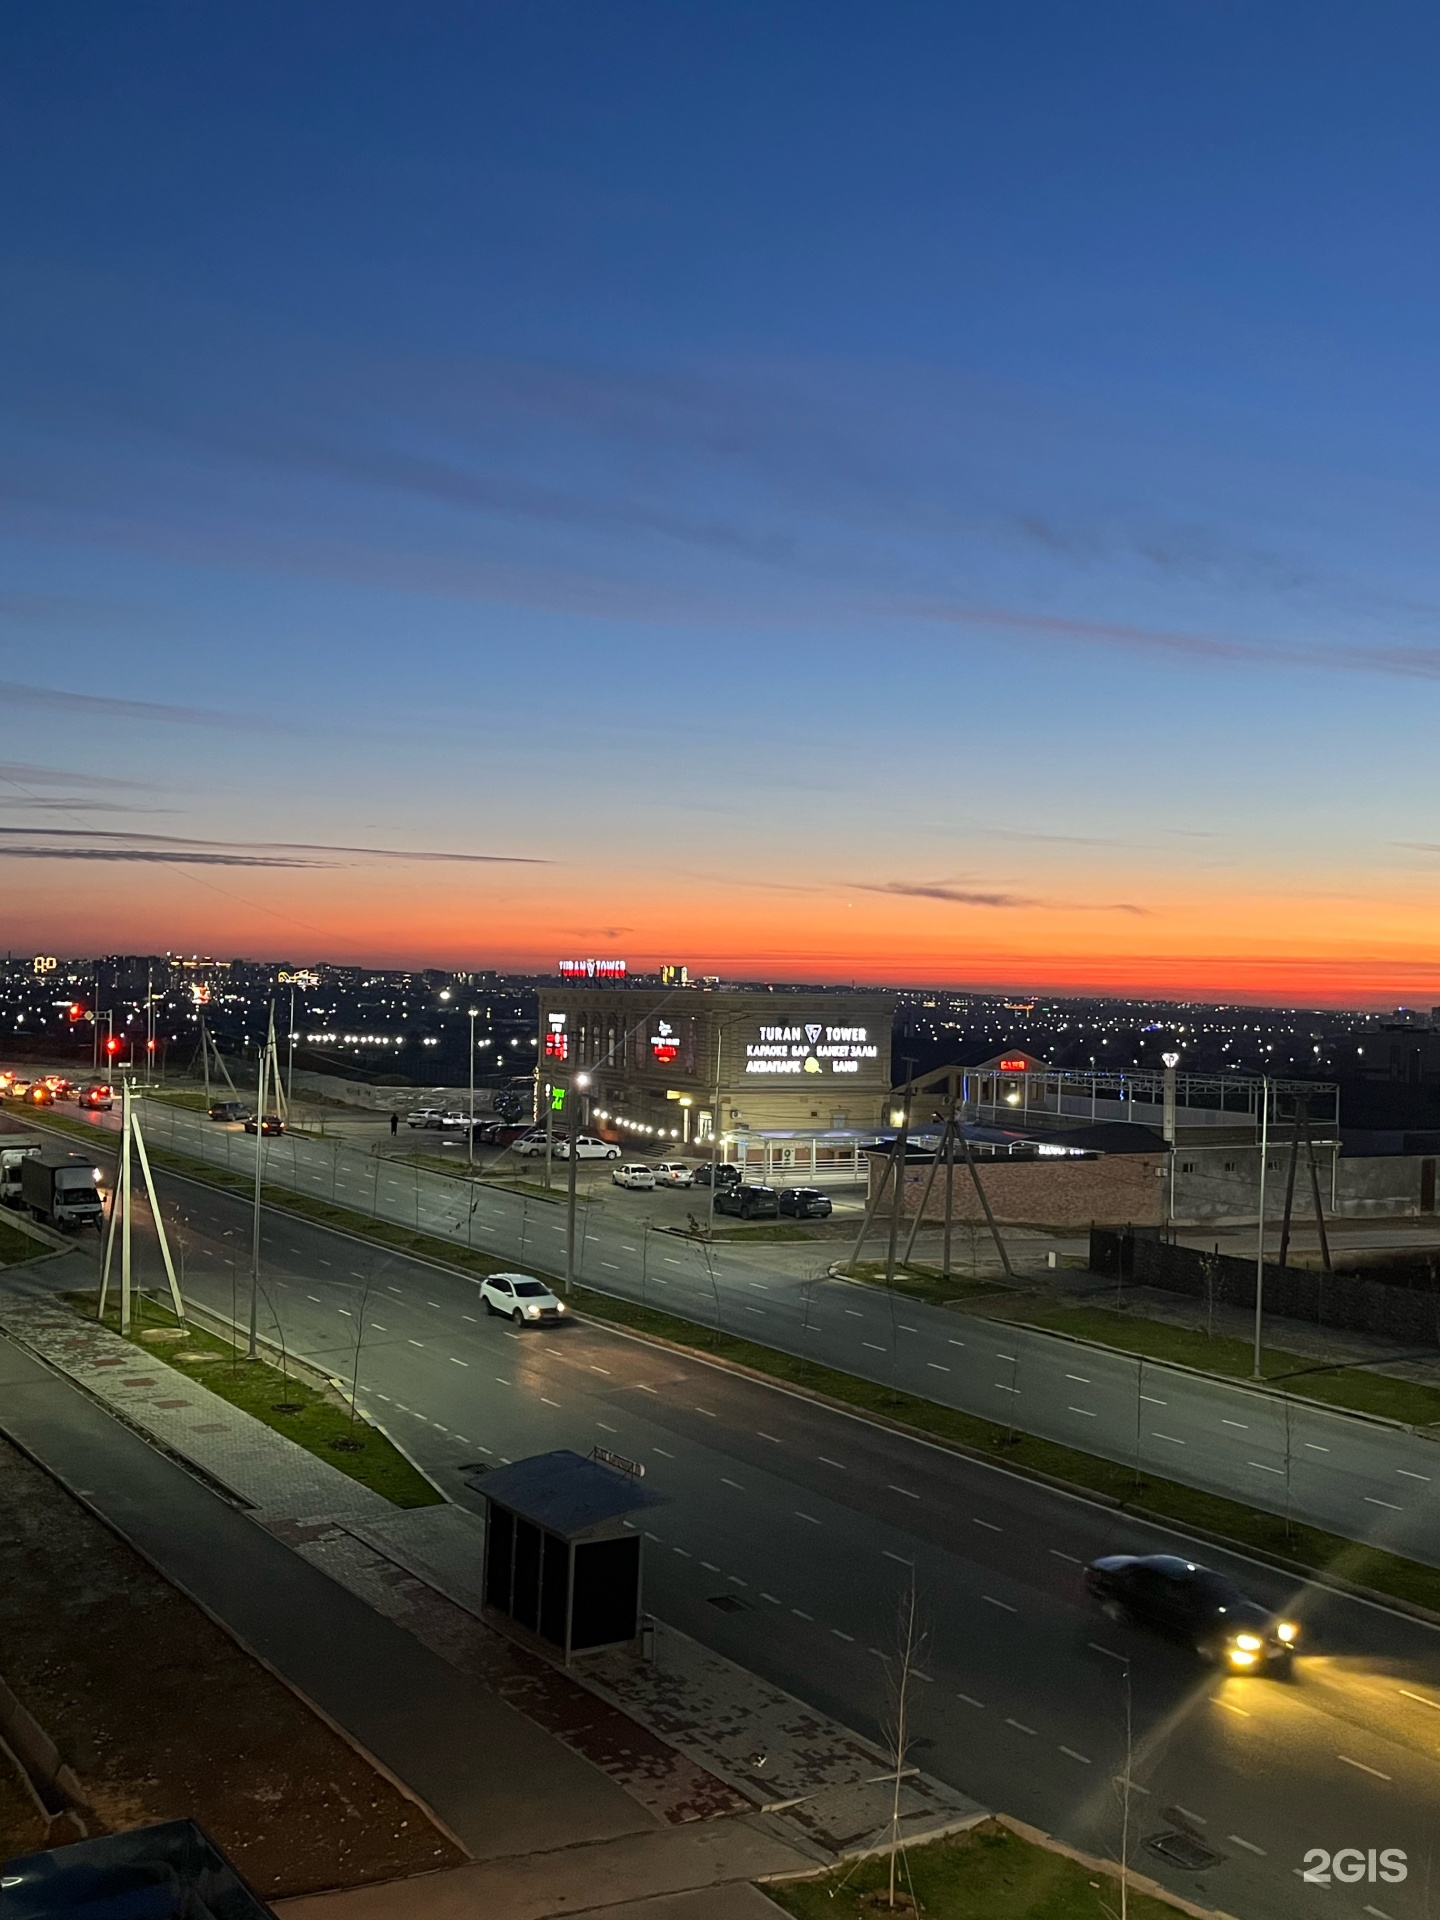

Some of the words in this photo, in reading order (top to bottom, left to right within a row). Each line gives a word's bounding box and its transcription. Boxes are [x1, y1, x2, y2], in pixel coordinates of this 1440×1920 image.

[559, 960, 586, 978] TURAN
[595, 960, 626, 979] TOWER
[760, 1026, 801, 1041] TURAN
[825, 1026, 867, 1042] TOWER
[746, 1045, 788, 1057] КАРАОКЕ
[791, 1045, 811, 1057] БАР
[816, 1045, 849, 1057] БАНКЕТ
[850, 1045, 877, 1057] ЗАЛЫ
[745, 1060, 801, 1073] АКВАПАРК
